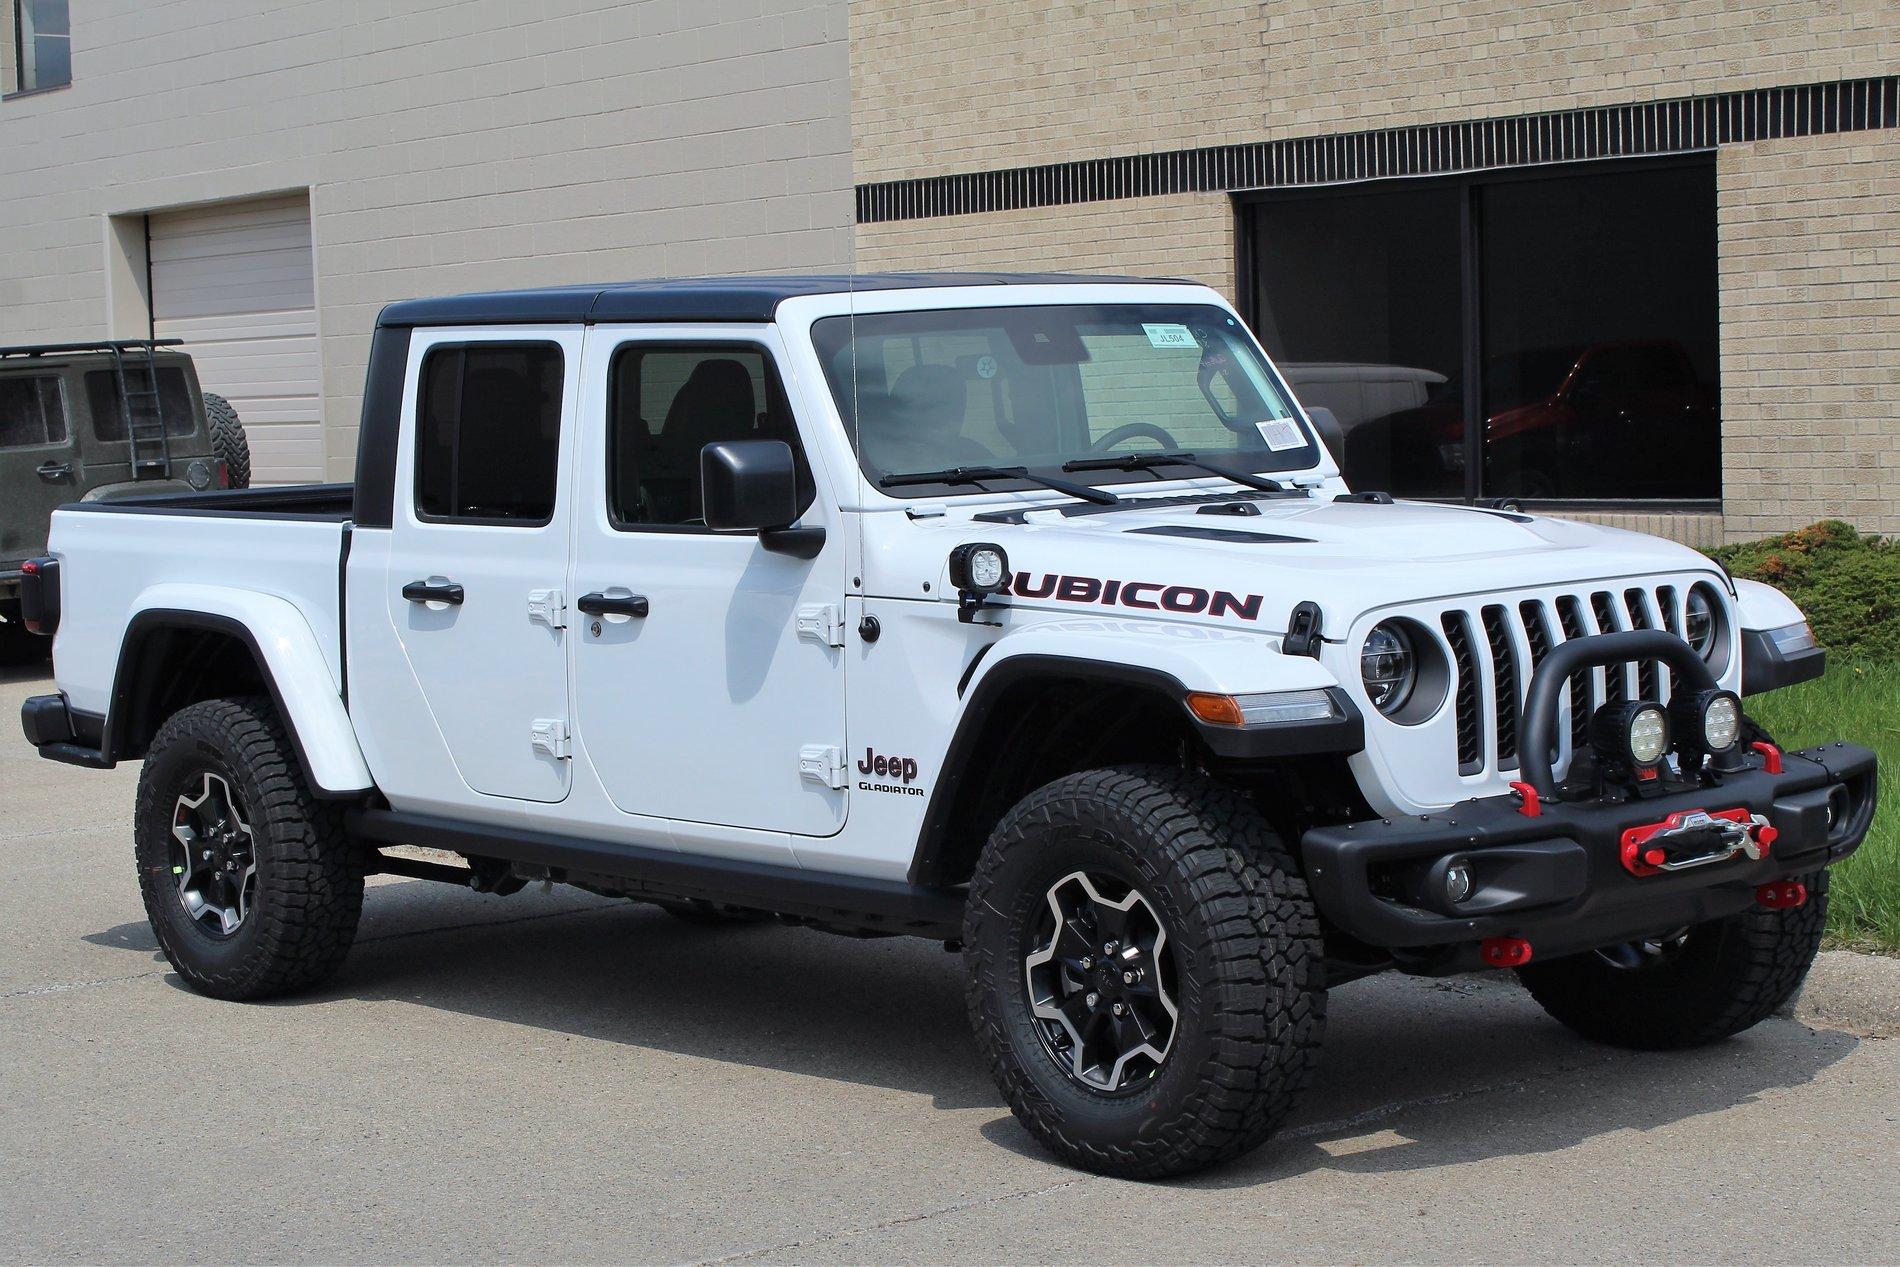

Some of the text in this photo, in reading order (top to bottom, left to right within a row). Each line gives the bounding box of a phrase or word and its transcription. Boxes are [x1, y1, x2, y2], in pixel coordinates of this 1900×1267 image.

[1160, 334, 1184, 343] JL504
[998, 571, 1264, 621] UBICON
[857, 747, 918, 785] Jeep
[858, 782, 925, 797] GLADIATOR
